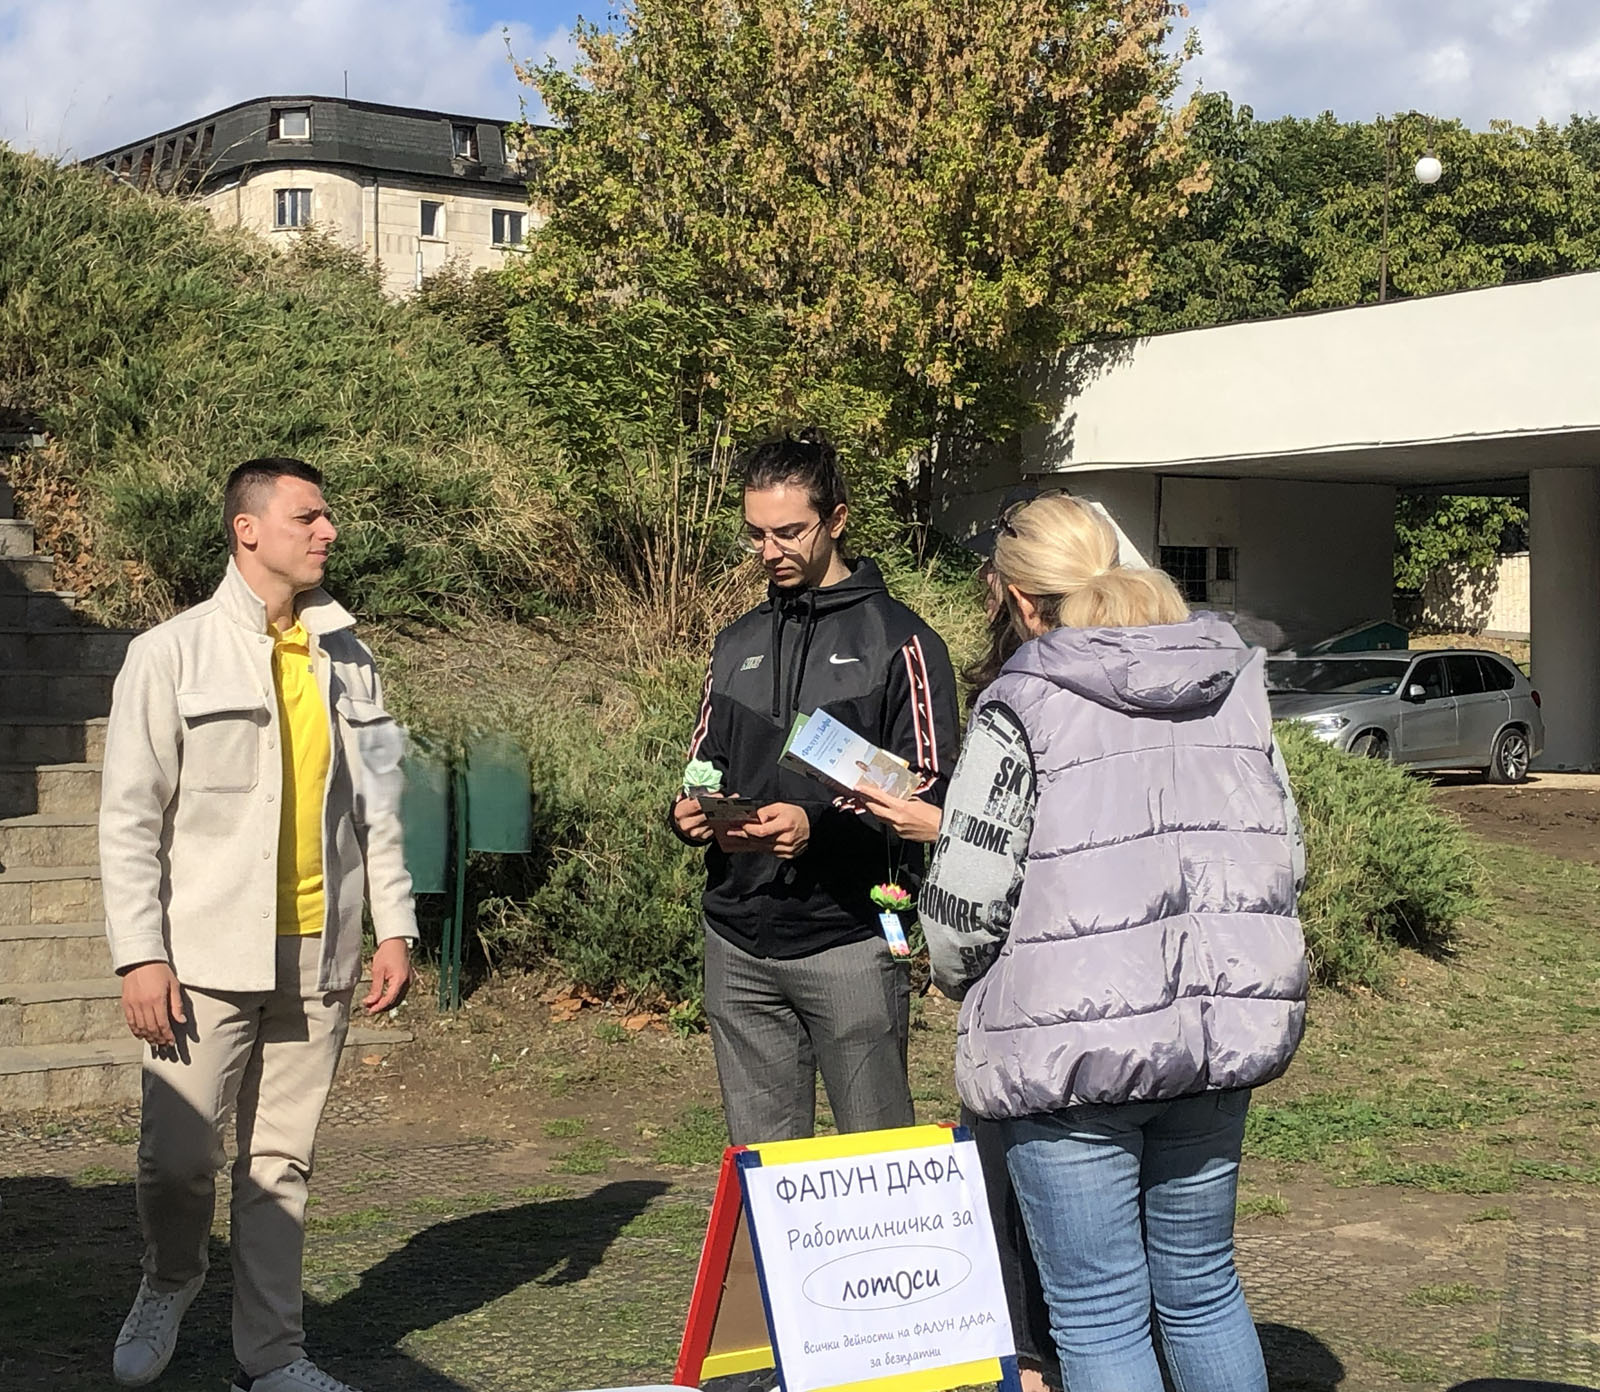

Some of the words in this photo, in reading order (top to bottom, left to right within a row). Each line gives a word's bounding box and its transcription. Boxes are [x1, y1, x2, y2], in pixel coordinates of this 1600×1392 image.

[918, 880, 983, 934] HONORE
[776, 1165, 878, 1204] ФАЛУН
[886, 1155, 965, 1197] ДАФА
[787, 1213, 945, 1251] Работилничка
[952, 1210, 974, 1228] за
[843, 1332, 895, 1348] дейности
[897, 1328, 910, 1339] на
[913, 1318, 955, 1336] ФАЛУН
[959, 1311, 996, 1331] ДАФА
[869, 1357, 882, 1368] за
[885, 1348, 942, 1366] безплатни
